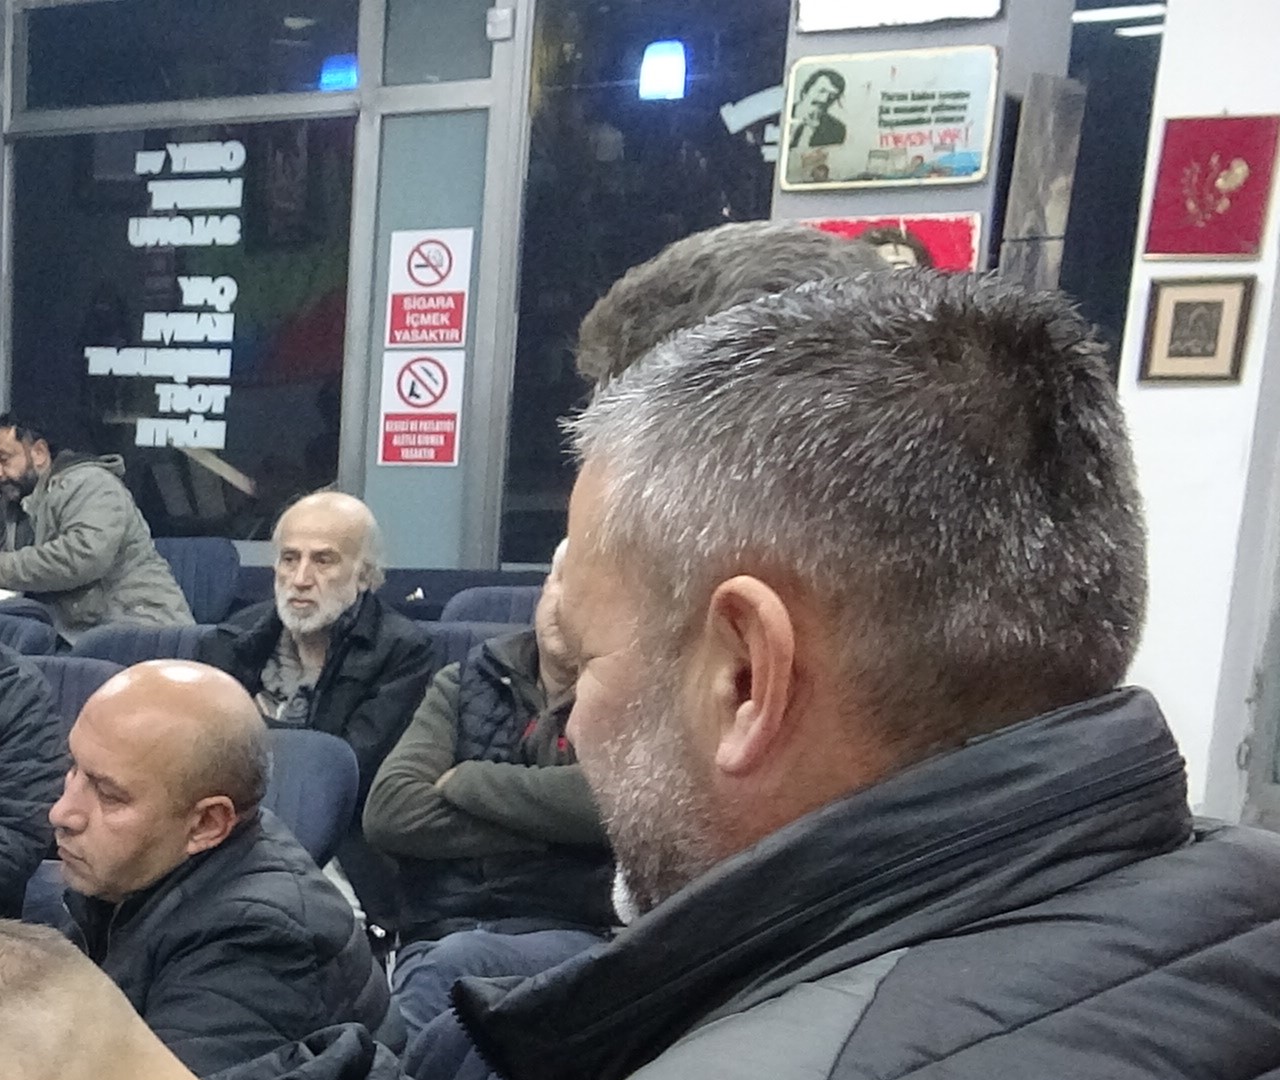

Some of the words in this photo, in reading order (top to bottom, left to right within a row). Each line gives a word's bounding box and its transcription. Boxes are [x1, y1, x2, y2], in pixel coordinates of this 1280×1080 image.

[403, 295, 455, 310] SİGARA
[405, 311, 451, 327] İÇMEK
[394, 328, 460, 341] YASAKTIR
